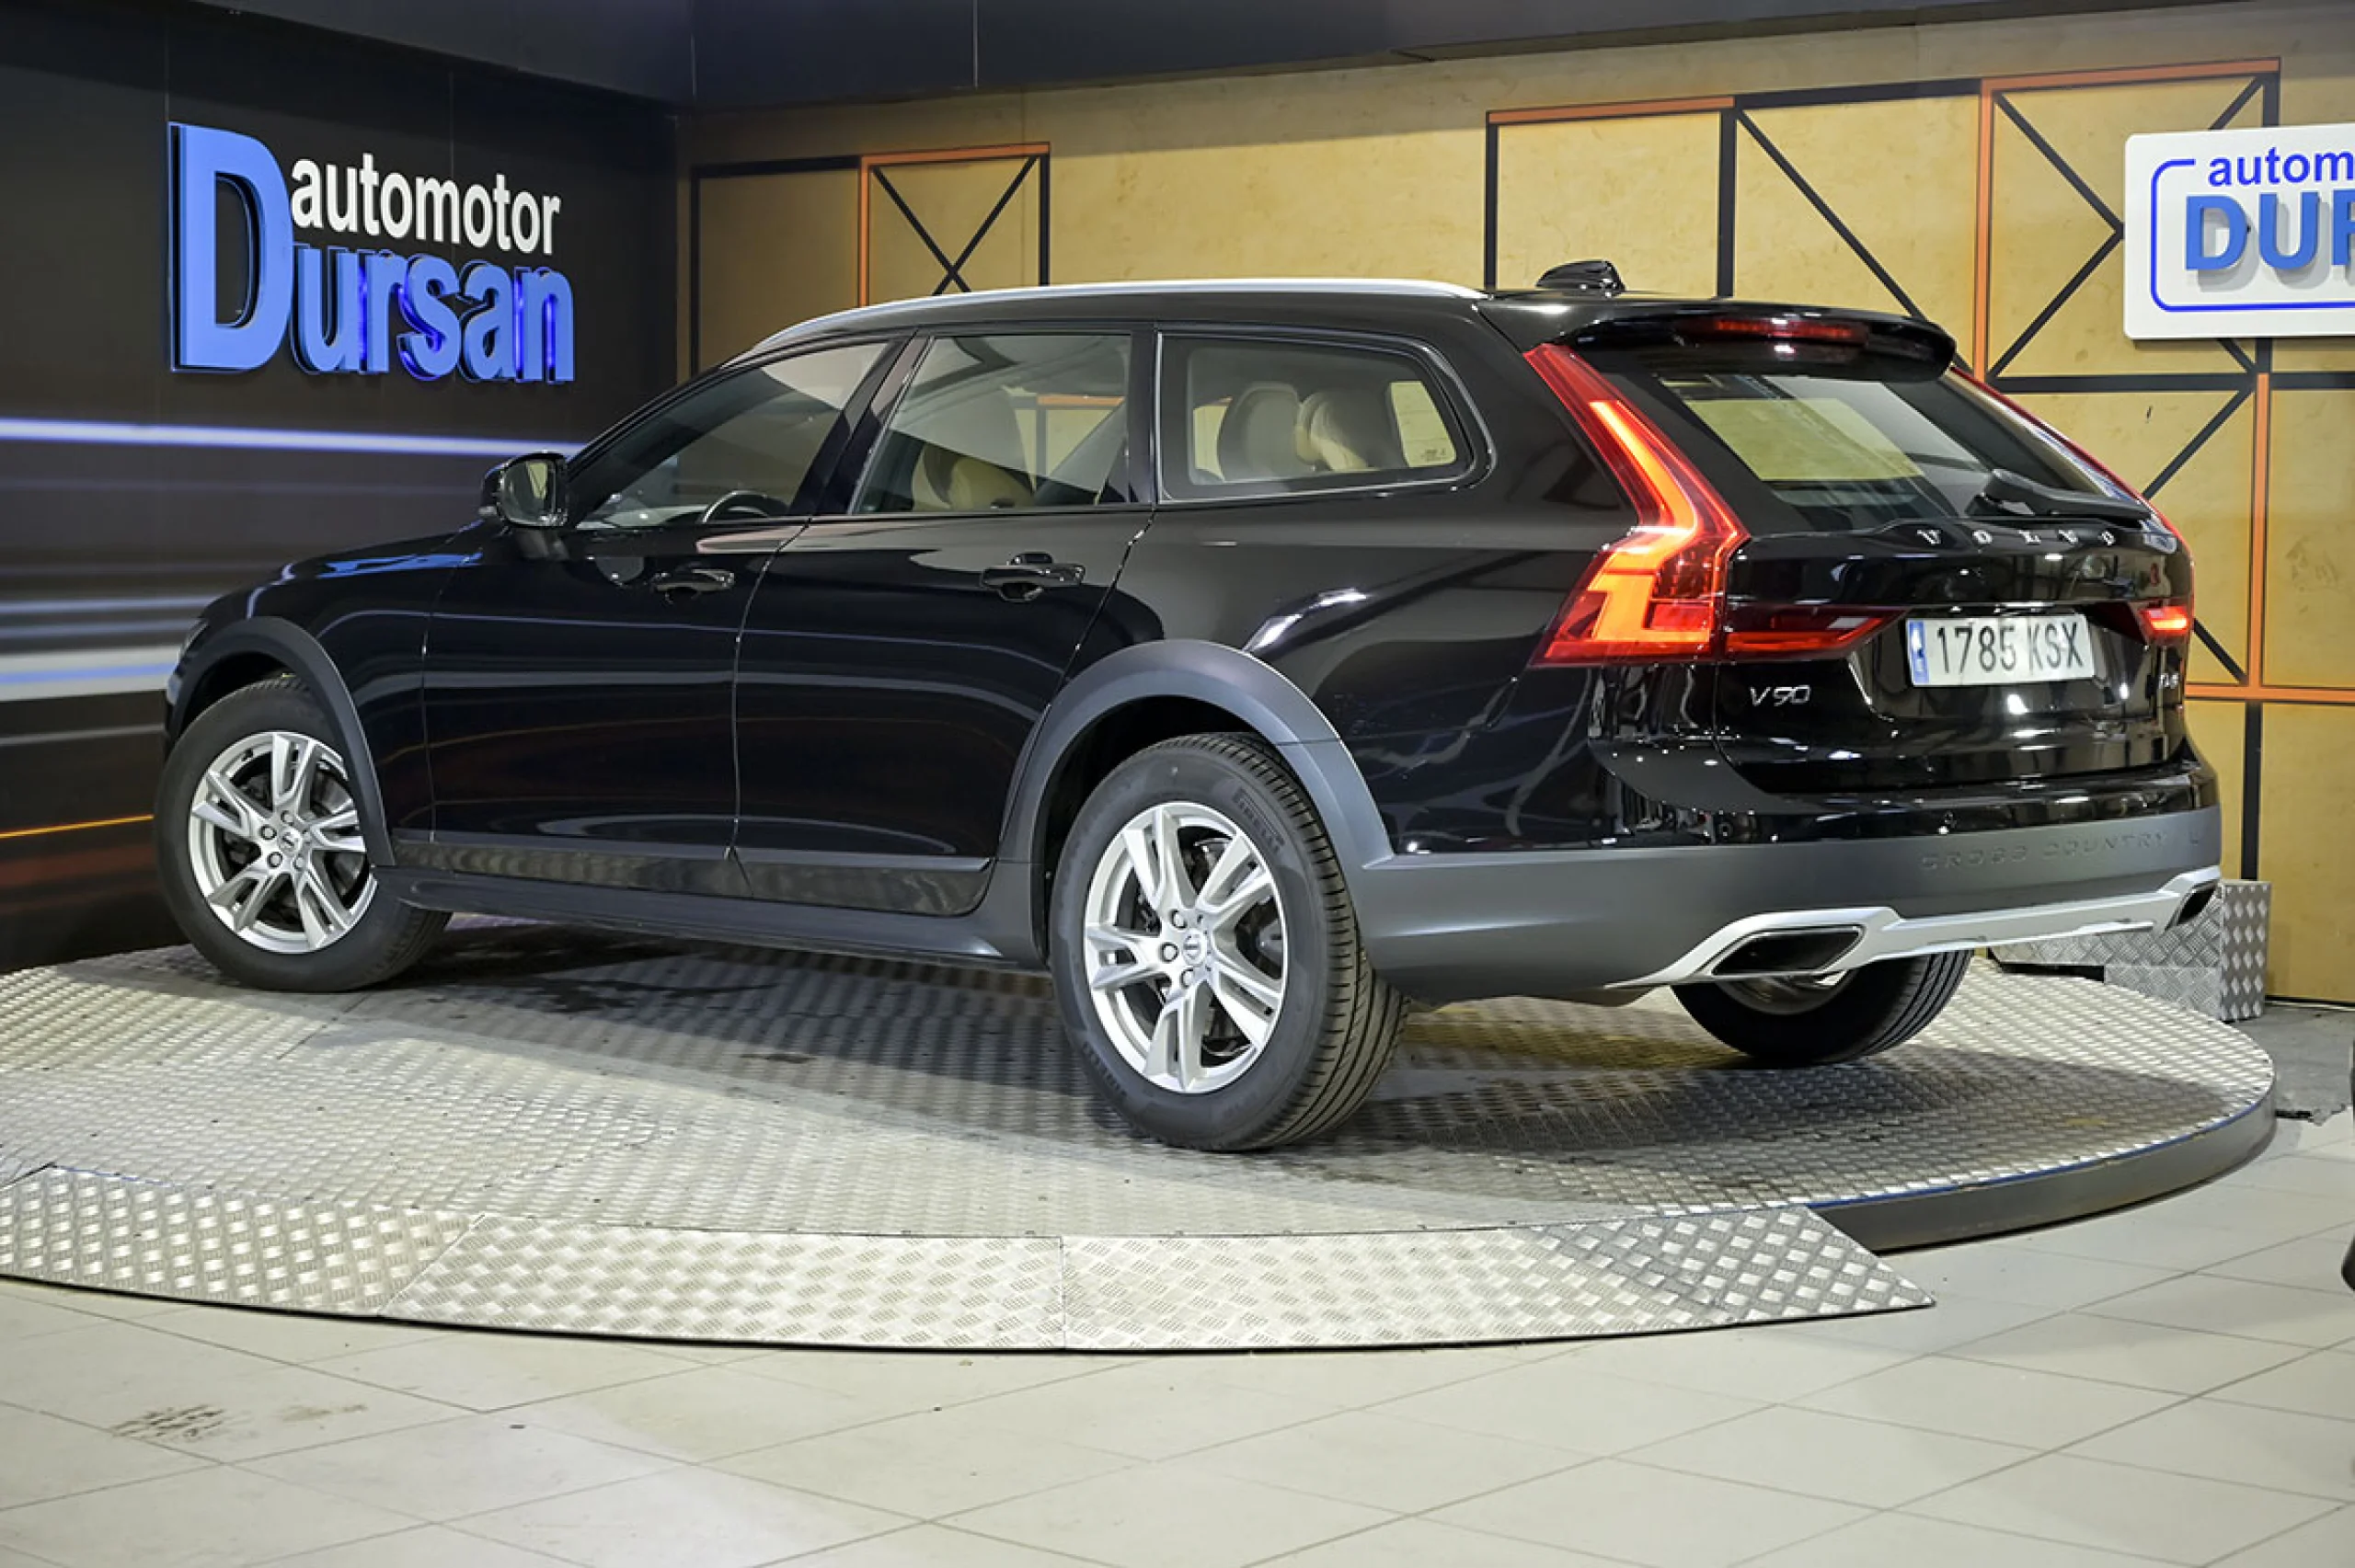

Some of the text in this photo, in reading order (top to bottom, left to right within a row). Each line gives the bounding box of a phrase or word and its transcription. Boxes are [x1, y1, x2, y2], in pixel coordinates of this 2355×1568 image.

[2208, 146, 2354, 187] autom
[291, 153, 561, 256] automotor
[168, 121, 575, 383] Dursan
[1916, 529, 2116, 546] VOLVO
[1937, 621, 2084, 674] 1785 KSX
[1750, 684, 1811, 706] V90
[1920, 831, 2168, 871] CROSS COUNTRY
